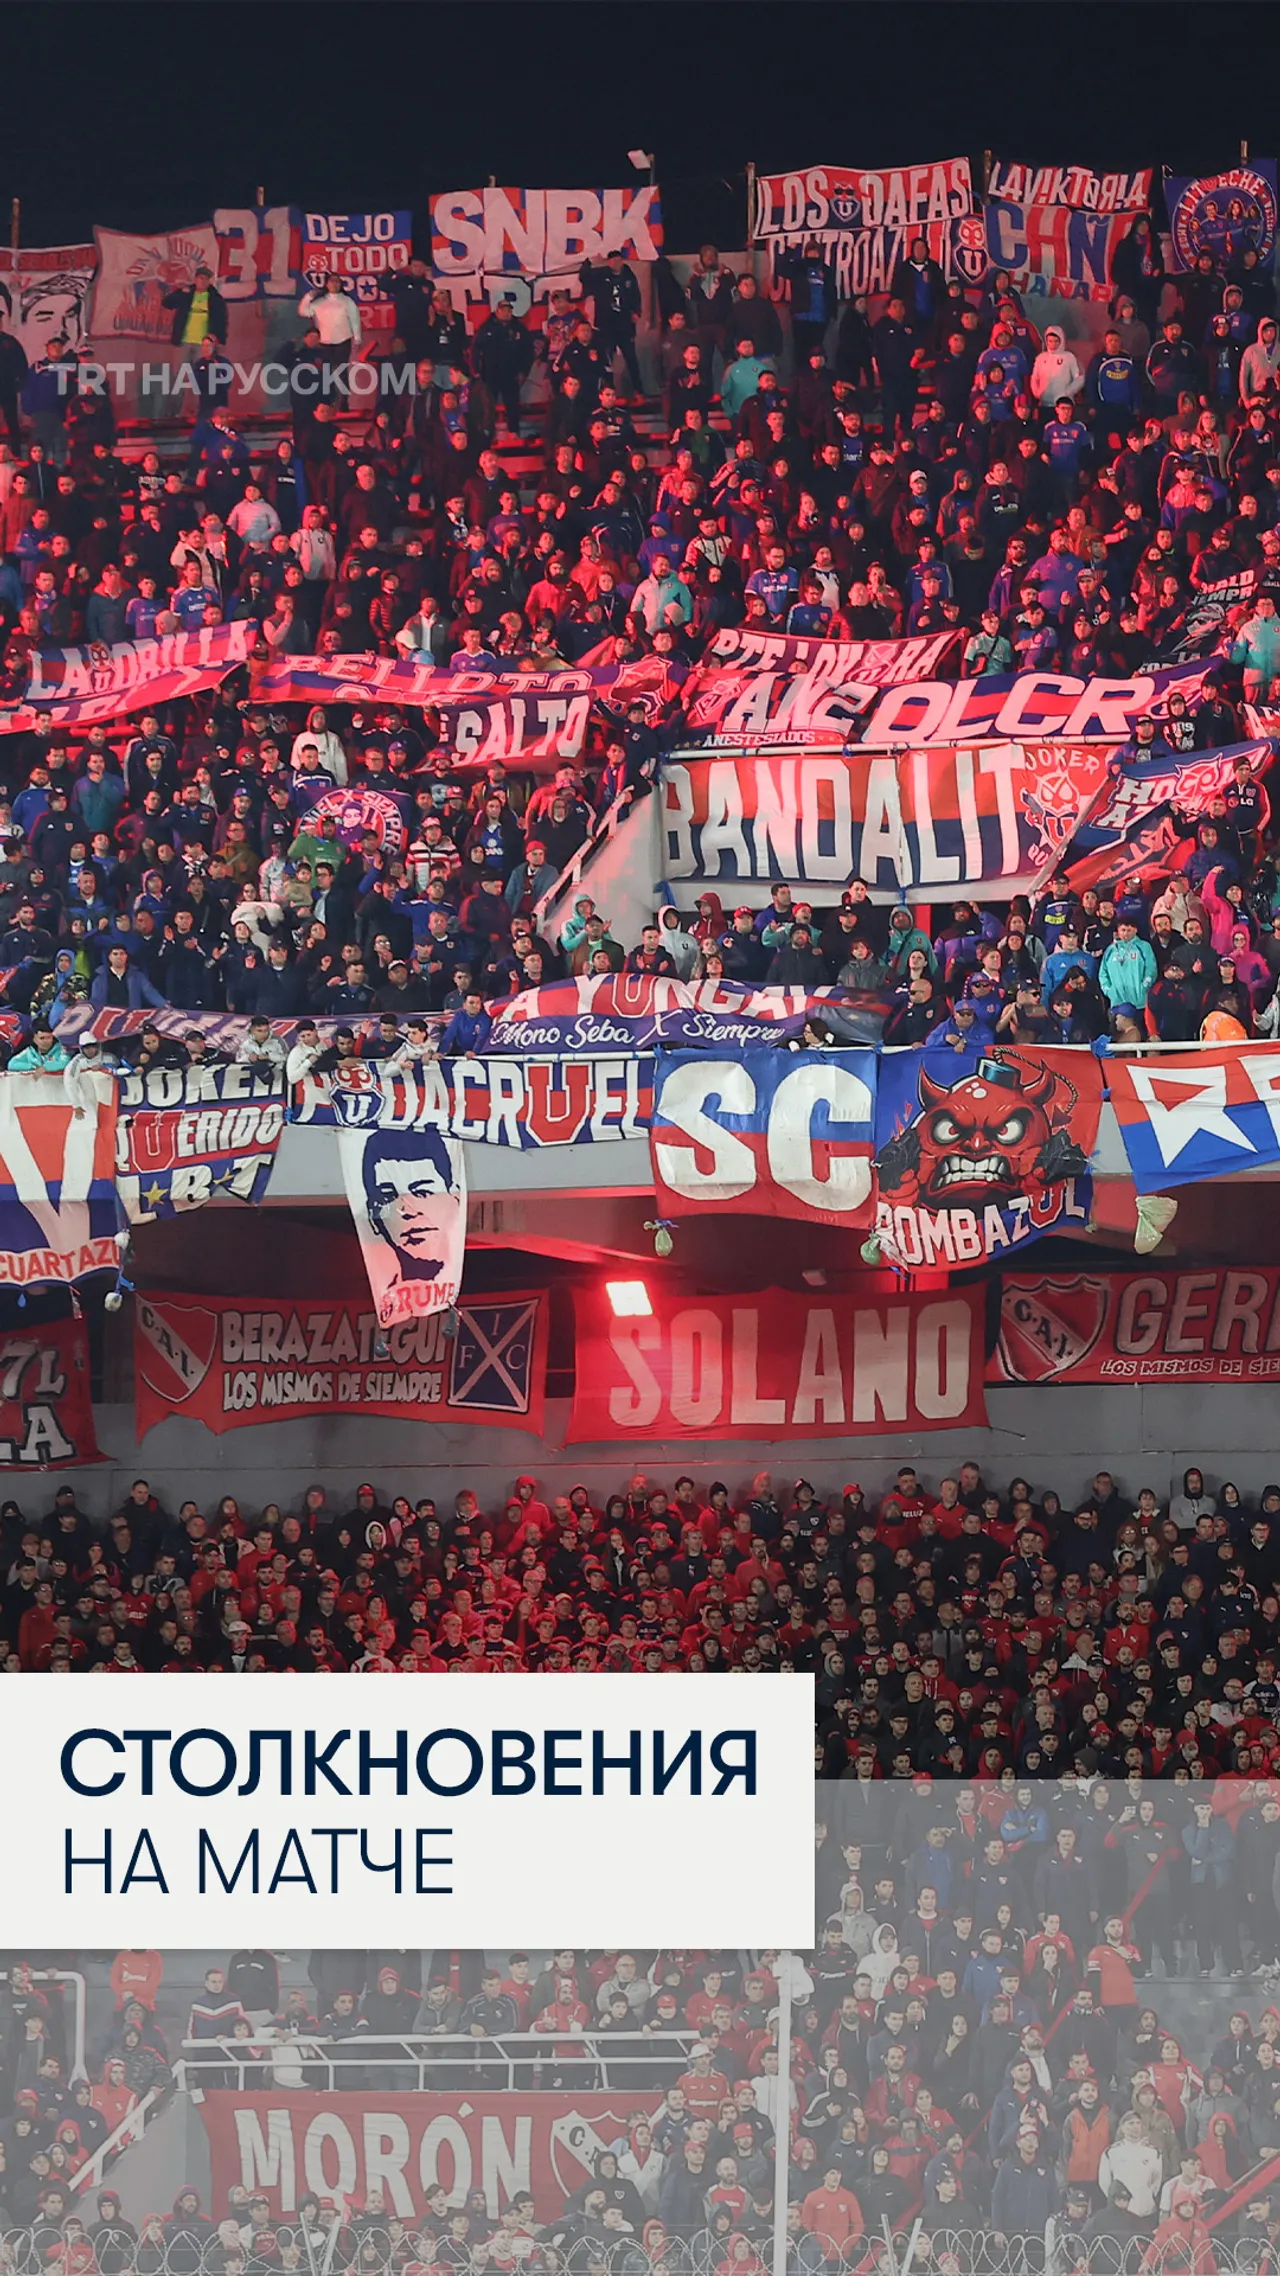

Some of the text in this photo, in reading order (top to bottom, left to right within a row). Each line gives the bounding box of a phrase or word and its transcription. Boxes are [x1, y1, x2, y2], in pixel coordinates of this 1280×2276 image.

[305, 213, 395, 243] DEJO
[760, 170, 829, 234] LOS
[214, 207, 297, 299] 31
[432, 185, 659, 275] SNBK
[324, 243, 409, 273] TODO
[702, 730, 816, 747] ANESTESIADOS
[1025, 746, 1100, 775] JOKER
[566, 1013, 635, 1047] Seba
[653, 1061, 873, 1212] SC
[1116, 1271, 1280, 1355] GER
[607, 1299, 972, 1427] SOLANO
[1101, 1359, 1137, 1375] LOS
[1139, 1359, 1214, 1376] MISMOS
[1219, 1360, 1242, 1375] DE
[222, 1371, 444, 1412] LOS MISMOS DE SIEMPRE
[234, 2101, 532, 2219] MORÓN
